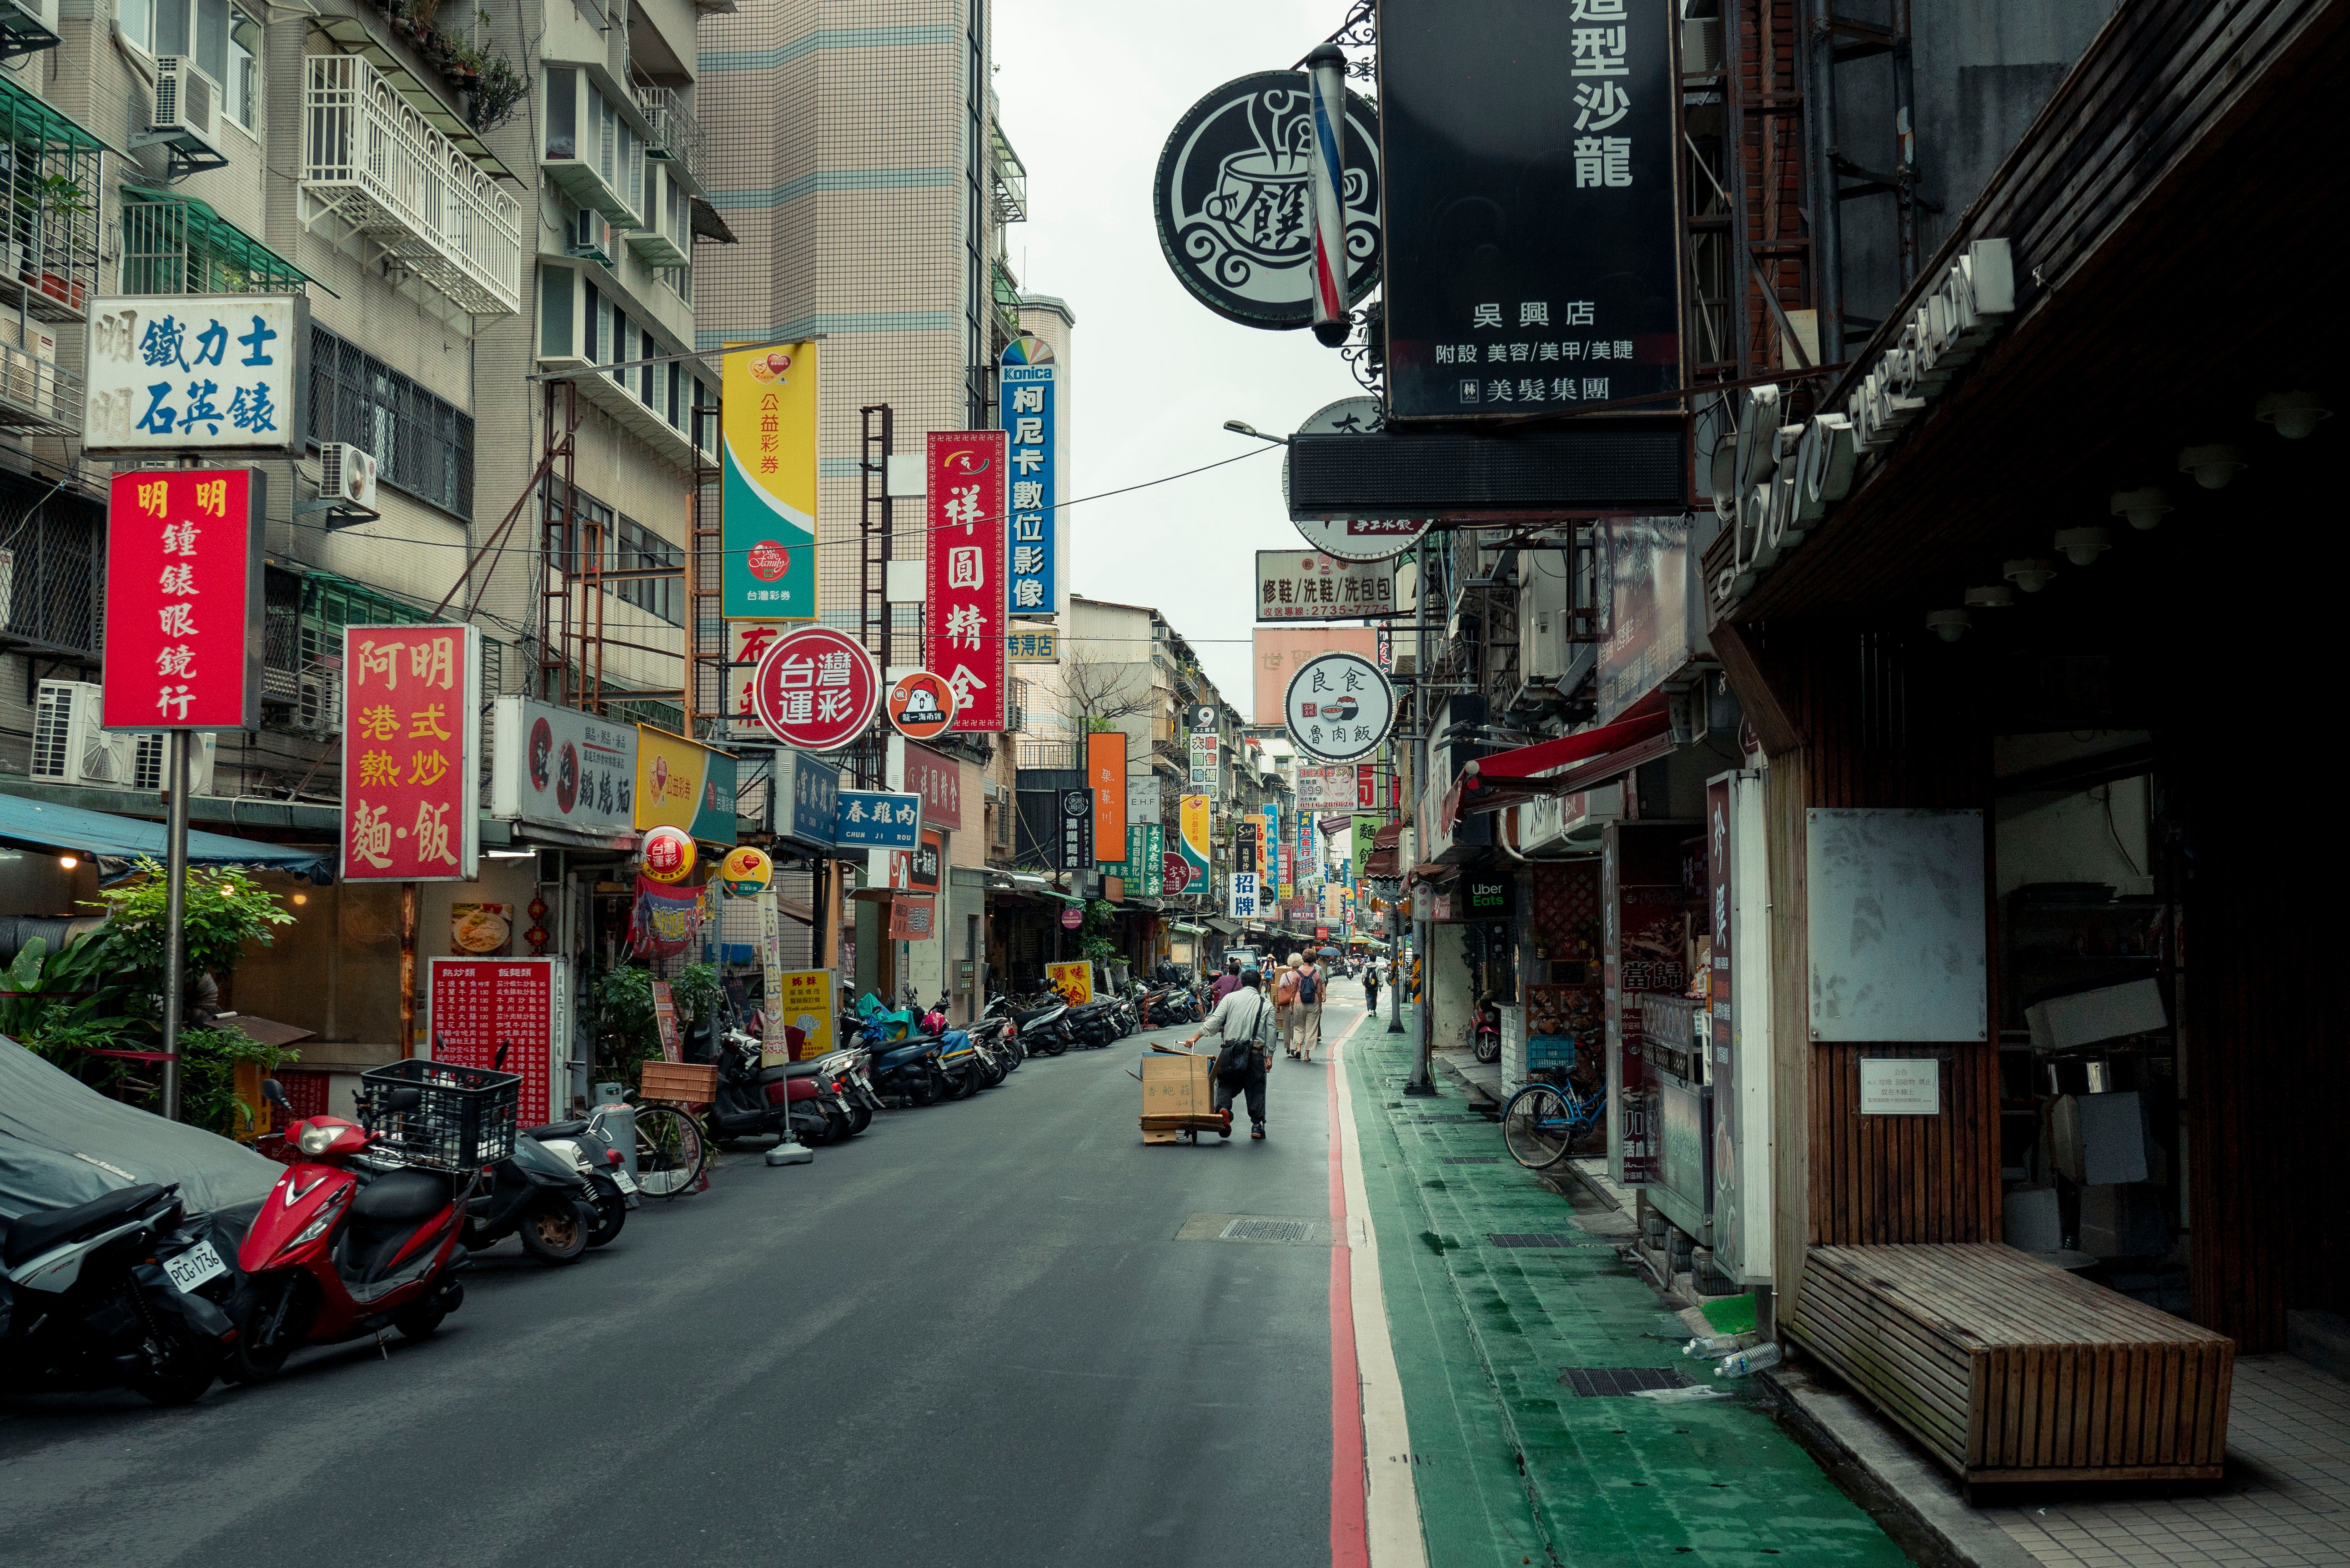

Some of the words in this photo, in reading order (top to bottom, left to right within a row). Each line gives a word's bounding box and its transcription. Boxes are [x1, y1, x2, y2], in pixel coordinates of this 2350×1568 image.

[1474, 300, 1594, 328] 吳興店
[139, 315, 277, 373] 鐵力士
[1436, 344, 1477, 364] 附設
[1488, 341, 1633, 362] 美容/美甲/美睫
[1004, 367, 1053, 381] Konica
[1487, 377, 1609, 403] 美髮集團
[136, 378, 277, 435] 石英錶
[760, 393, 779, 474] 公益彩券
[138, 479, 226, 518] 明明
[1013, 387, 1045, 608] 柯尼卡數位影像
[1354, 519, 1413, 531] 手工水餃
[747, 590, 790, 600] 台灣彩券
[944, 484, 988, 709] 祥圓精舍
[1263, 577, 1391, 604] 修鞋/洗鞋/洗包包
[156, 520, 201, 720] 鐘錶眼鏡行
[358, 637, 454, 691] 阿明
[780, 650, 852, 687] 台灣
[1312, 666, 1366, 692] 良食
[778, 688, 854, 725] 運彩
[902, 713, 942, 722] 龍一海南雞
[358, 703, 452, 741] 港式
[1309, 724, 1373, 744] 魯肉飯
[359, 749, 450, 787] 熱炒
[1300, 768, 1335, 778] 凍齡美容
[1336, 768, 1353, 777] SPA
[667, 774, 691, 800] 公益彩券
[920, 764, 957, 812] 祥圓精舍
[1299, 786, 1323, 796] 699
[839, 799, 916, 825] 春雞肉
[1238, 825, 1255, 838] Style
[652, 842, 676, 855] 台灣
[652, 854, 677, 867] 運彩
[1148, 826, 1160, 873] 美の洗衣坊
[1235, 874, 1255, 916] 招牌
[1472, 884, 1503, 895] Uber
[1473, 895, 1504, 907] Eats
[442, 969, 476, 977] 熱炒類
[498, 968, 532, 977] 飯麵類
[792, 976, 817, 986] 姊妹
[1053, 965, 1085, 981] 滷味
[1622, 961, 1684, 990] 當歸
[171, 1249, 220, 1286] PCG-1736
